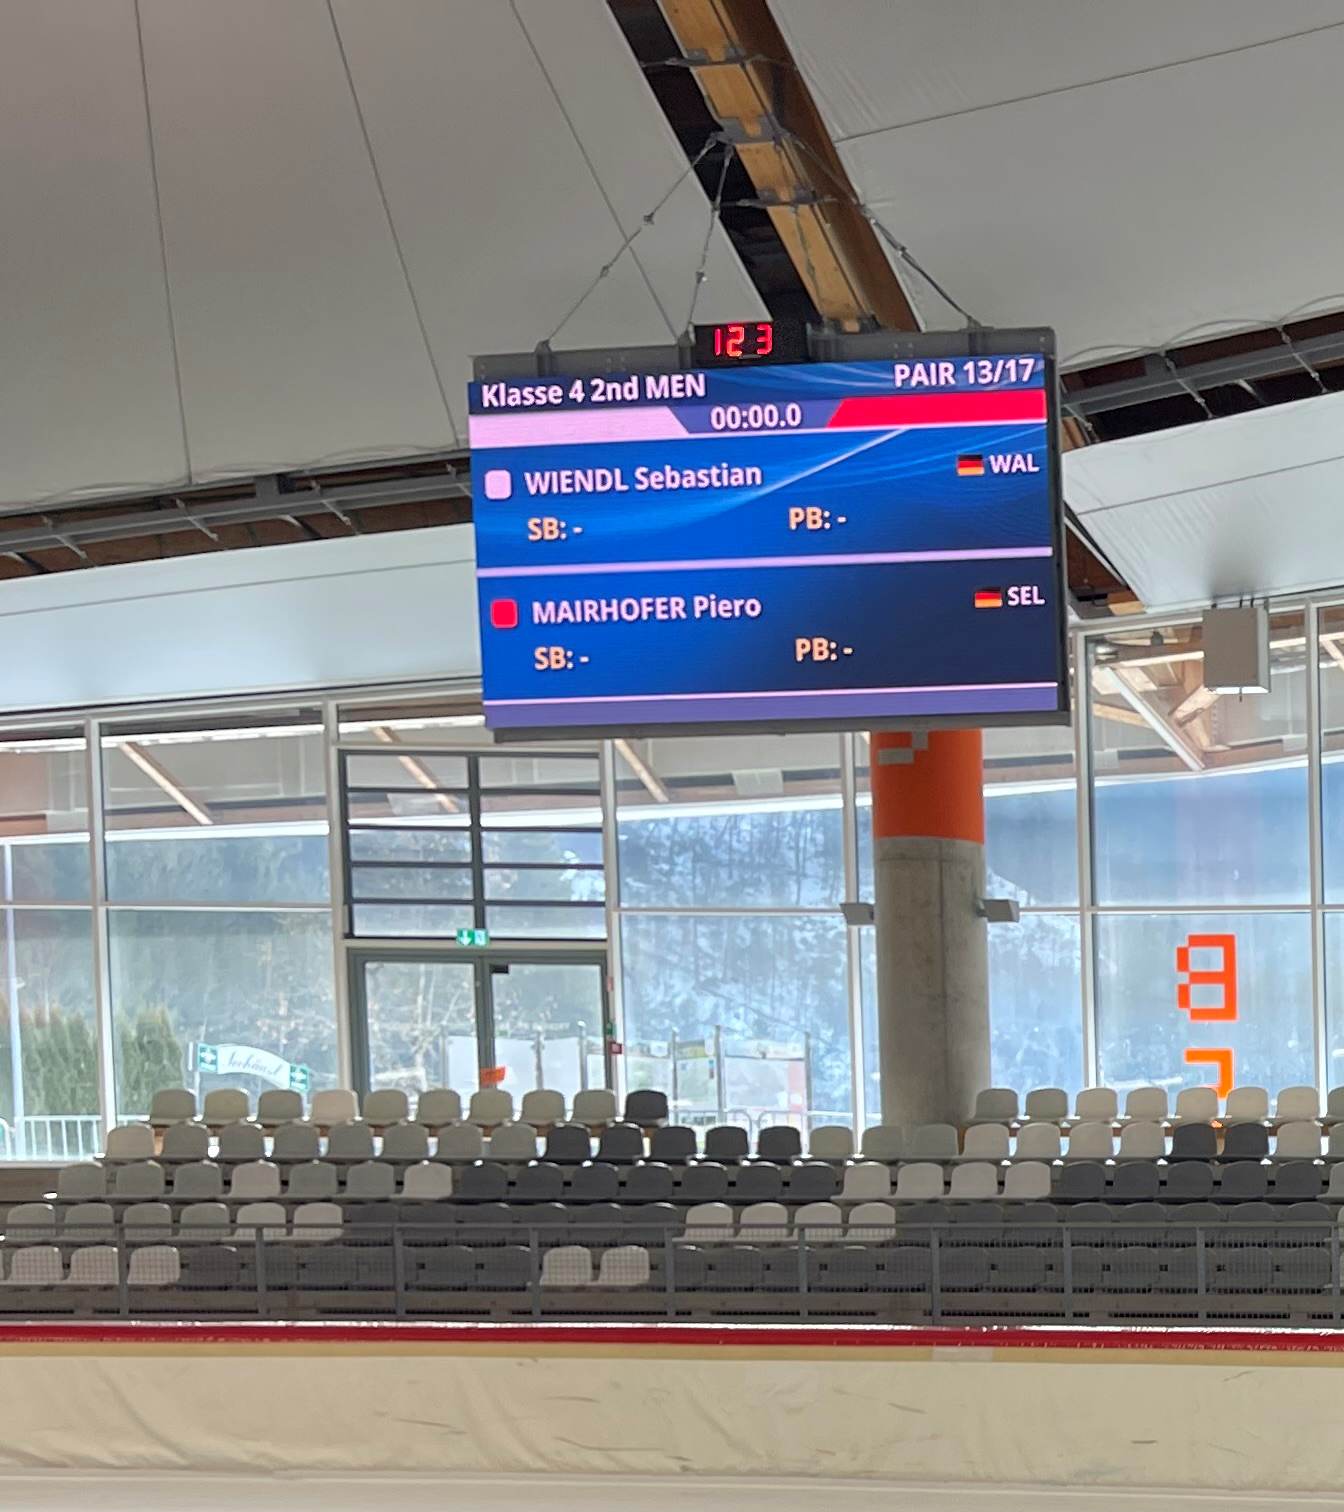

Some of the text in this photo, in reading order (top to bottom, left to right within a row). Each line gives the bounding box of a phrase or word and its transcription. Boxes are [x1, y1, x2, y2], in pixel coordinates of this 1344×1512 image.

[894, 358, 1035, 387] PAIR 13/17
[481, 374, 706, 408] Klasse 4 2nd MEN
[710, 402, 802, 431] 00:00.0
[989, 454, 1041, 475] WAL
[523, 463, 763, 496] WIENDL Sebastian
[527, 517, 568, 541] SB:
[788, 507, 832, 531] PB:
[1007, 586, 1046, 607] SEL
[532, 594, 763, 625] MAIRHOFER Piero
[533, 647, 574, 671] SB:
[795, 638, 838, 661] PB:
